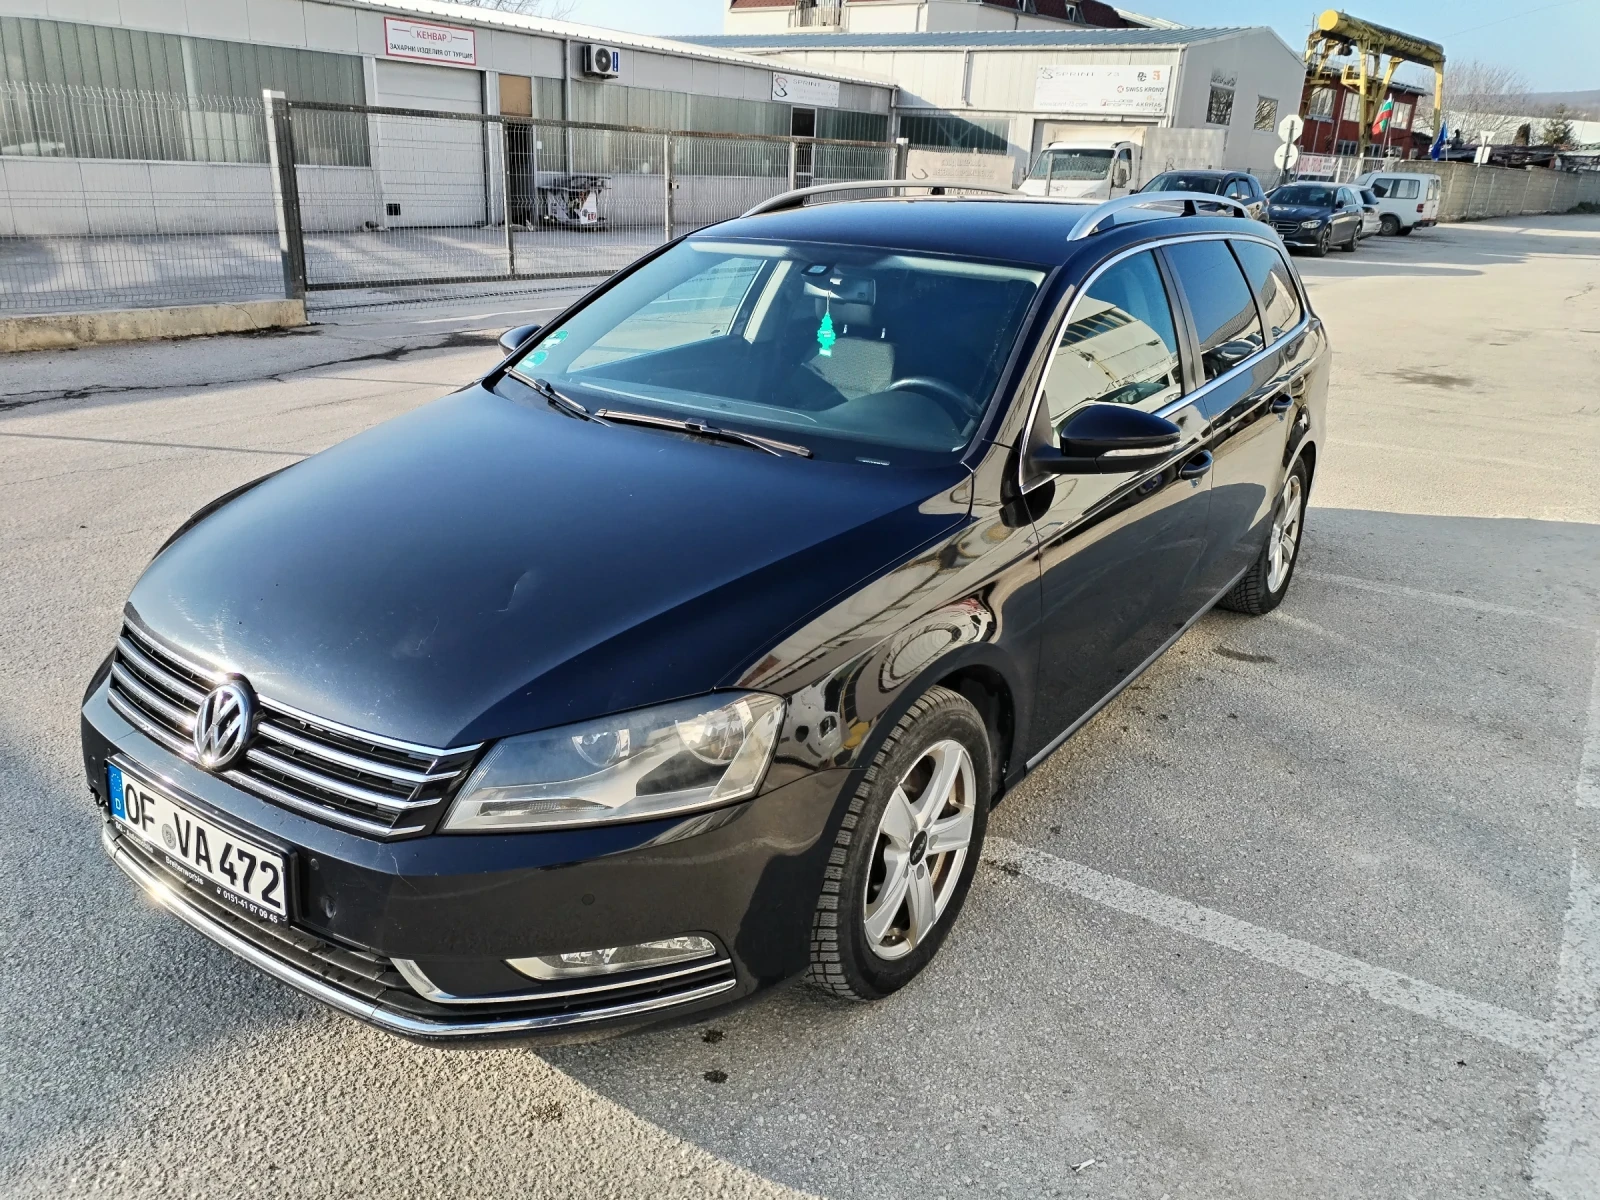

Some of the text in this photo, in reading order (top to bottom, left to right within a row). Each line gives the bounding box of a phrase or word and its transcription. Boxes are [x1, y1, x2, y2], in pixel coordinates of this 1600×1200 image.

[416, 30, 447, 42] КЕНВАР
[389, 42, 416, 53] ЗАХАРНИ
[417, 46, 443, 56] ИЗДЕЛИЯ
[792, 78, 821, 88] SPRINT
[115, 797, 121, 811] D
[125, 783, 281, 909] OF VA 472
[223, 890, 248, 909] 0151-41
[249, 903, 257, 914] 97
[258, 908, 267, 919] 09
[269, 913, 278, 924] 45
